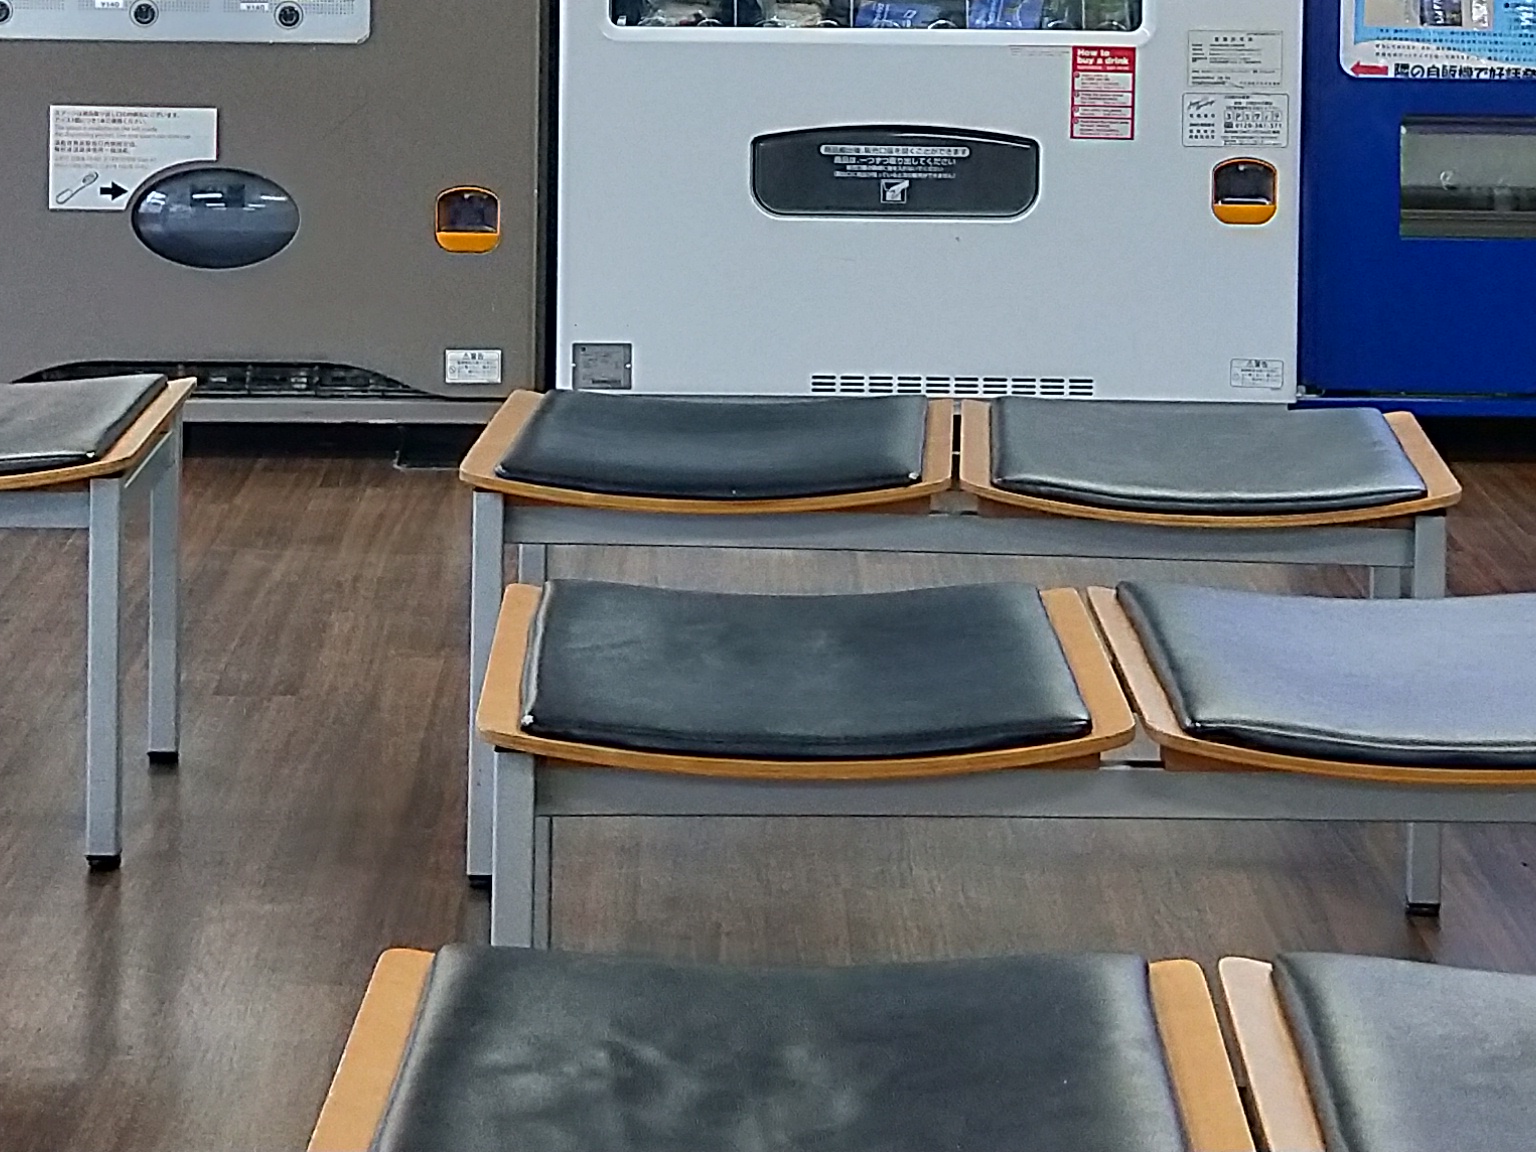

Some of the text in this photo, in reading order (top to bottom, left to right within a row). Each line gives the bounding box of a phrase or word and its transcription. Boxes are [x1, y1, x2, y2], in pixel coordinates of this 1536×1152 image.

[1076, 48, 1111, 58] How to
[1076, 57, 1096, 67] buy
[1105, 56, 1130, 66] drink
